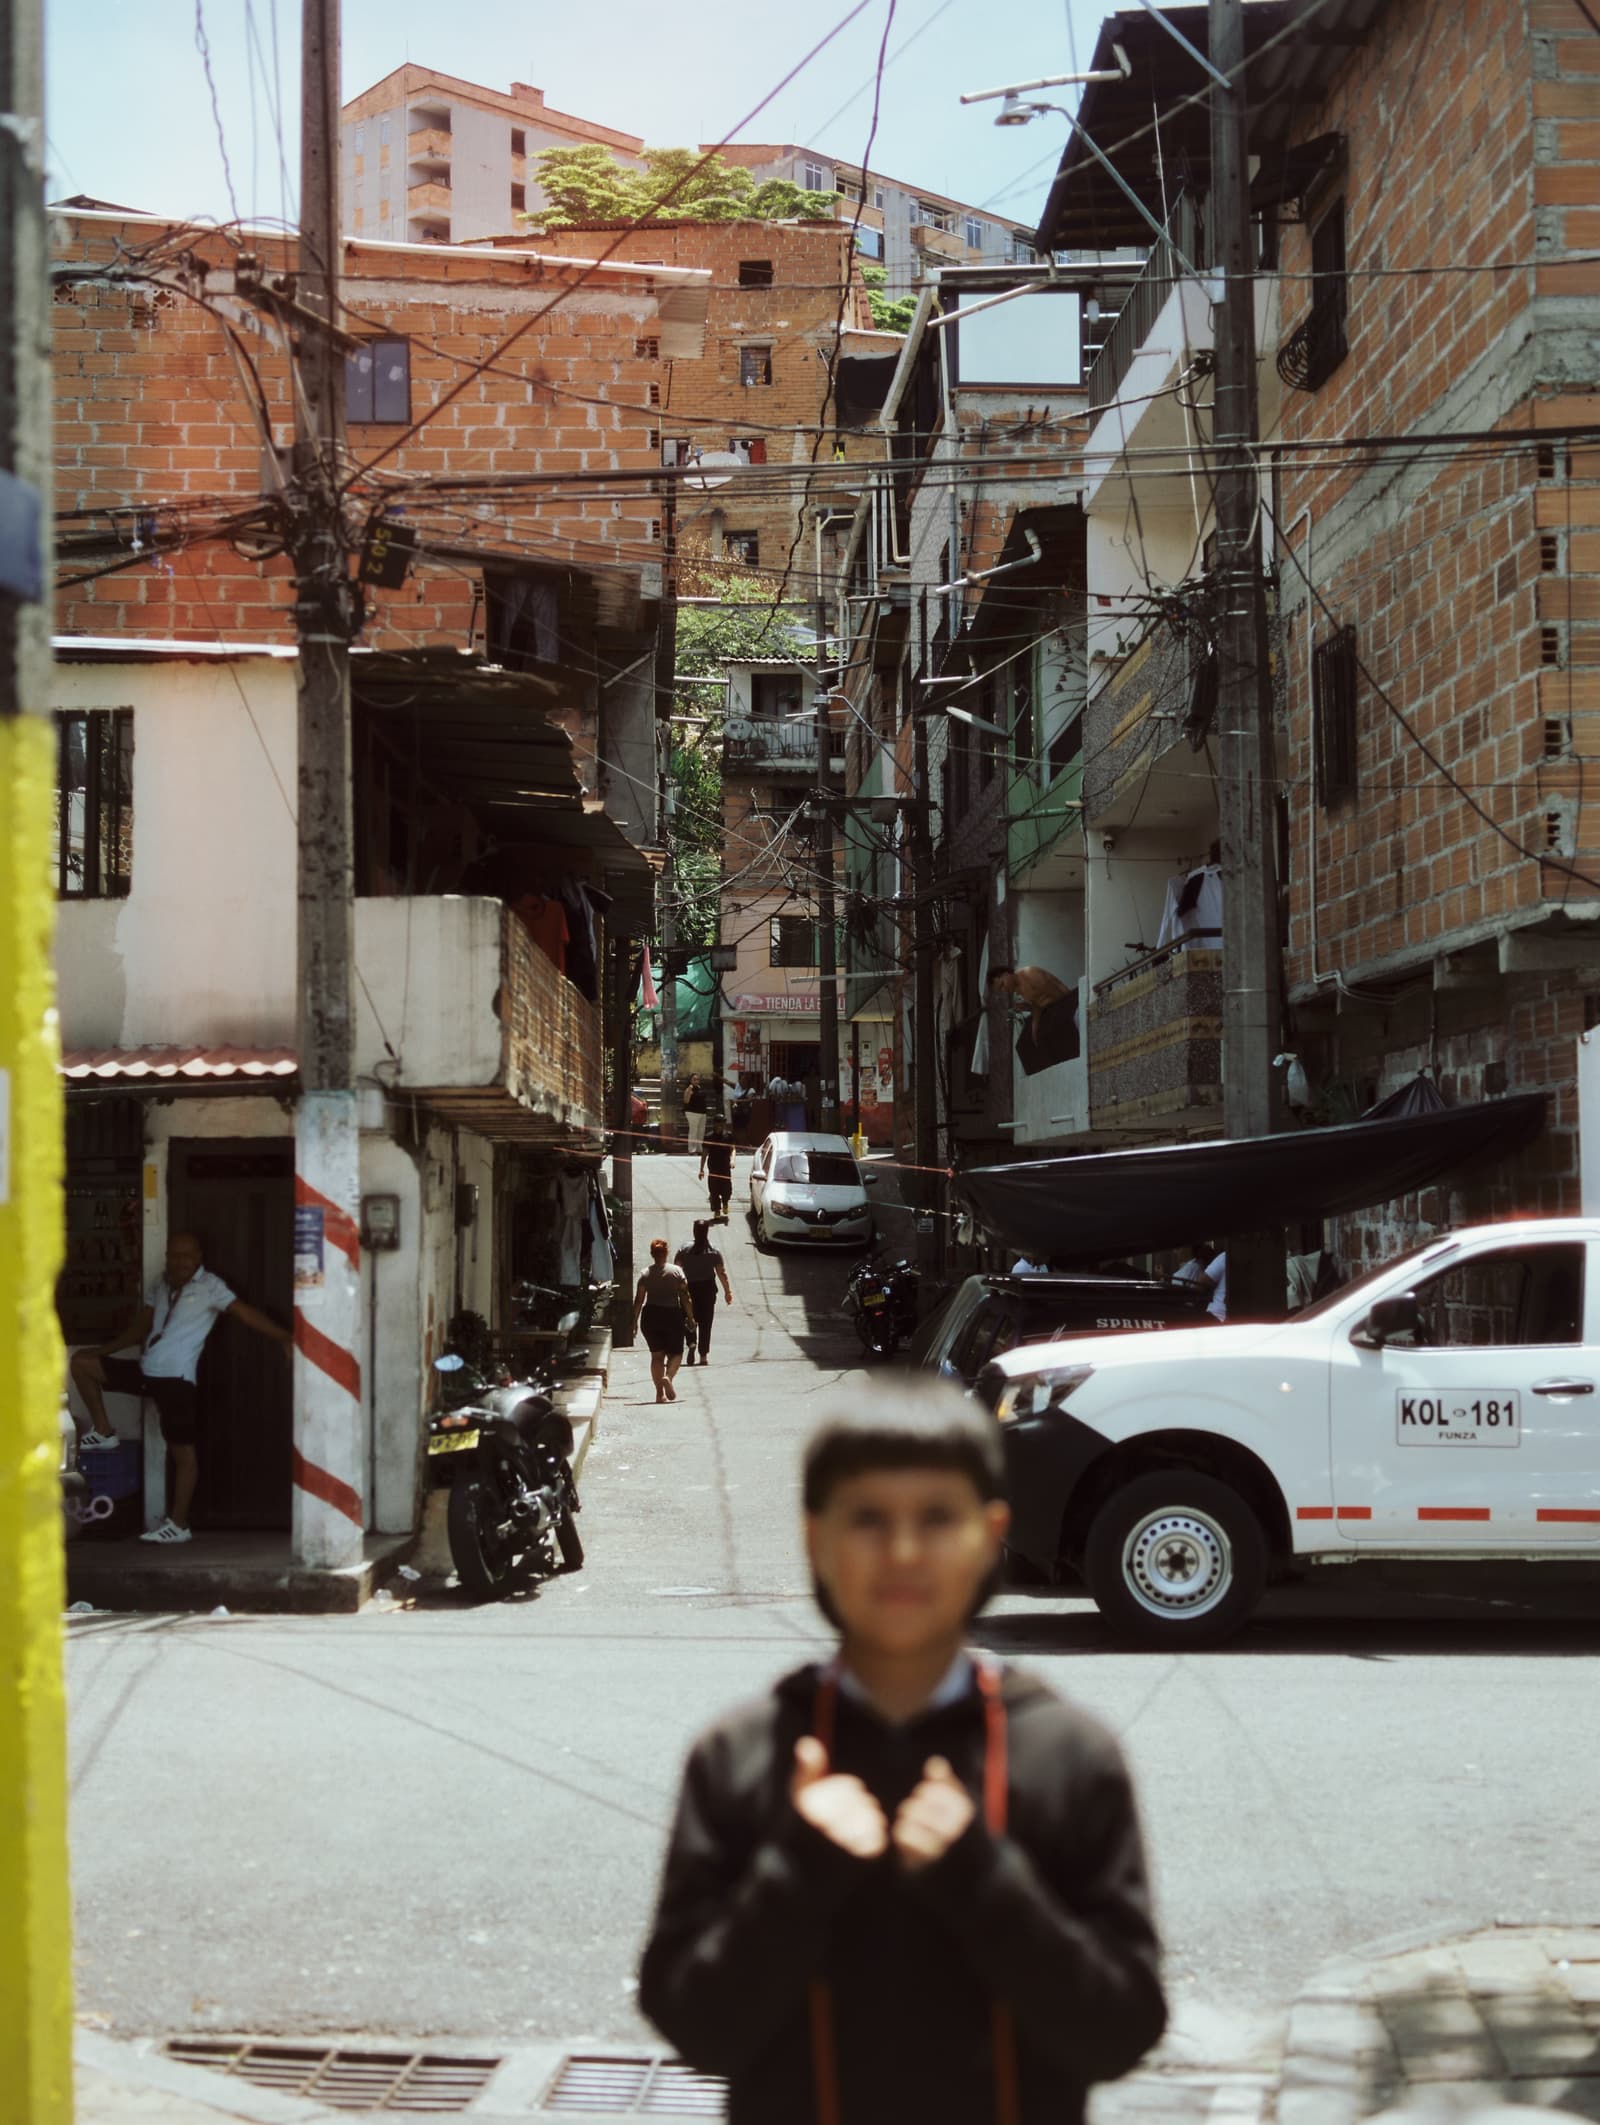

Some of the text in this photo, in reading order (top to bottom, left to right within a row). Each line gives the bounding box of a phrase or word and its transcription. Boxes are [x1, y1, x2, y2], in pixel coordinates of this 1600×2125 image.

[765, 996, 802, 1010] TIENDA
[805, 998, 816, 1010] LA
[1096, 1317, 1166, 1330] SPRINT
[1400, 1398, 1514, 1427] KOL 181
[1438, 1431, 1477, 1441] FUNZA
